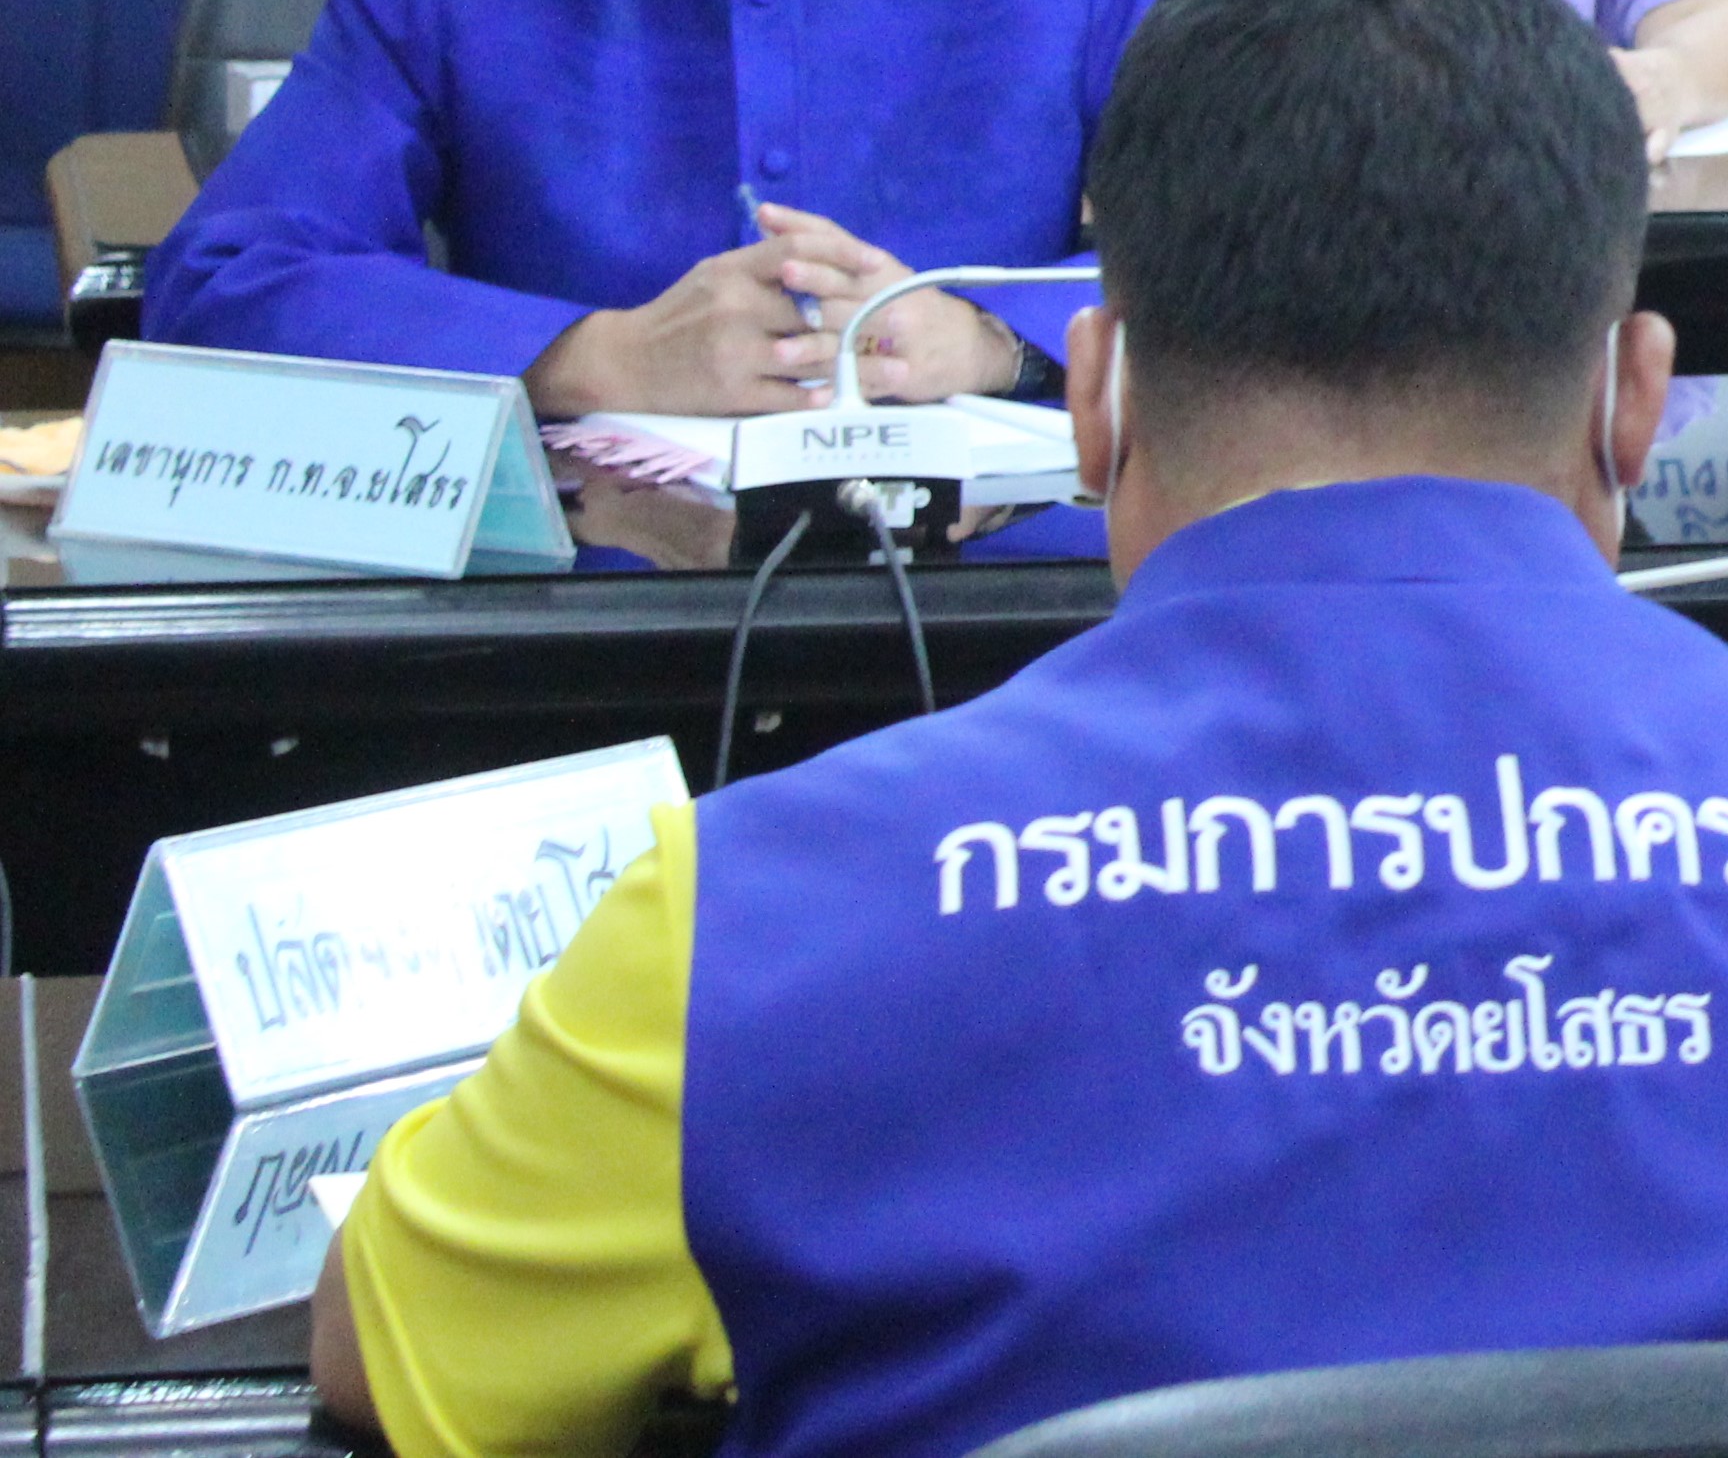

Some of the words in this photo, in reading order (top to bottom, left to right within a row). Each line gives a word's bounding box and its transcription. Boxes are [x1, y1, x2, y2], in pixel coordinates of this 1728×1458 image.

[802, 422, 912, 449] NPE
[95, 439, 254, 509] เลขานุการ
[1180, 954, 1713, 1077] จังหวัดยโสธร
